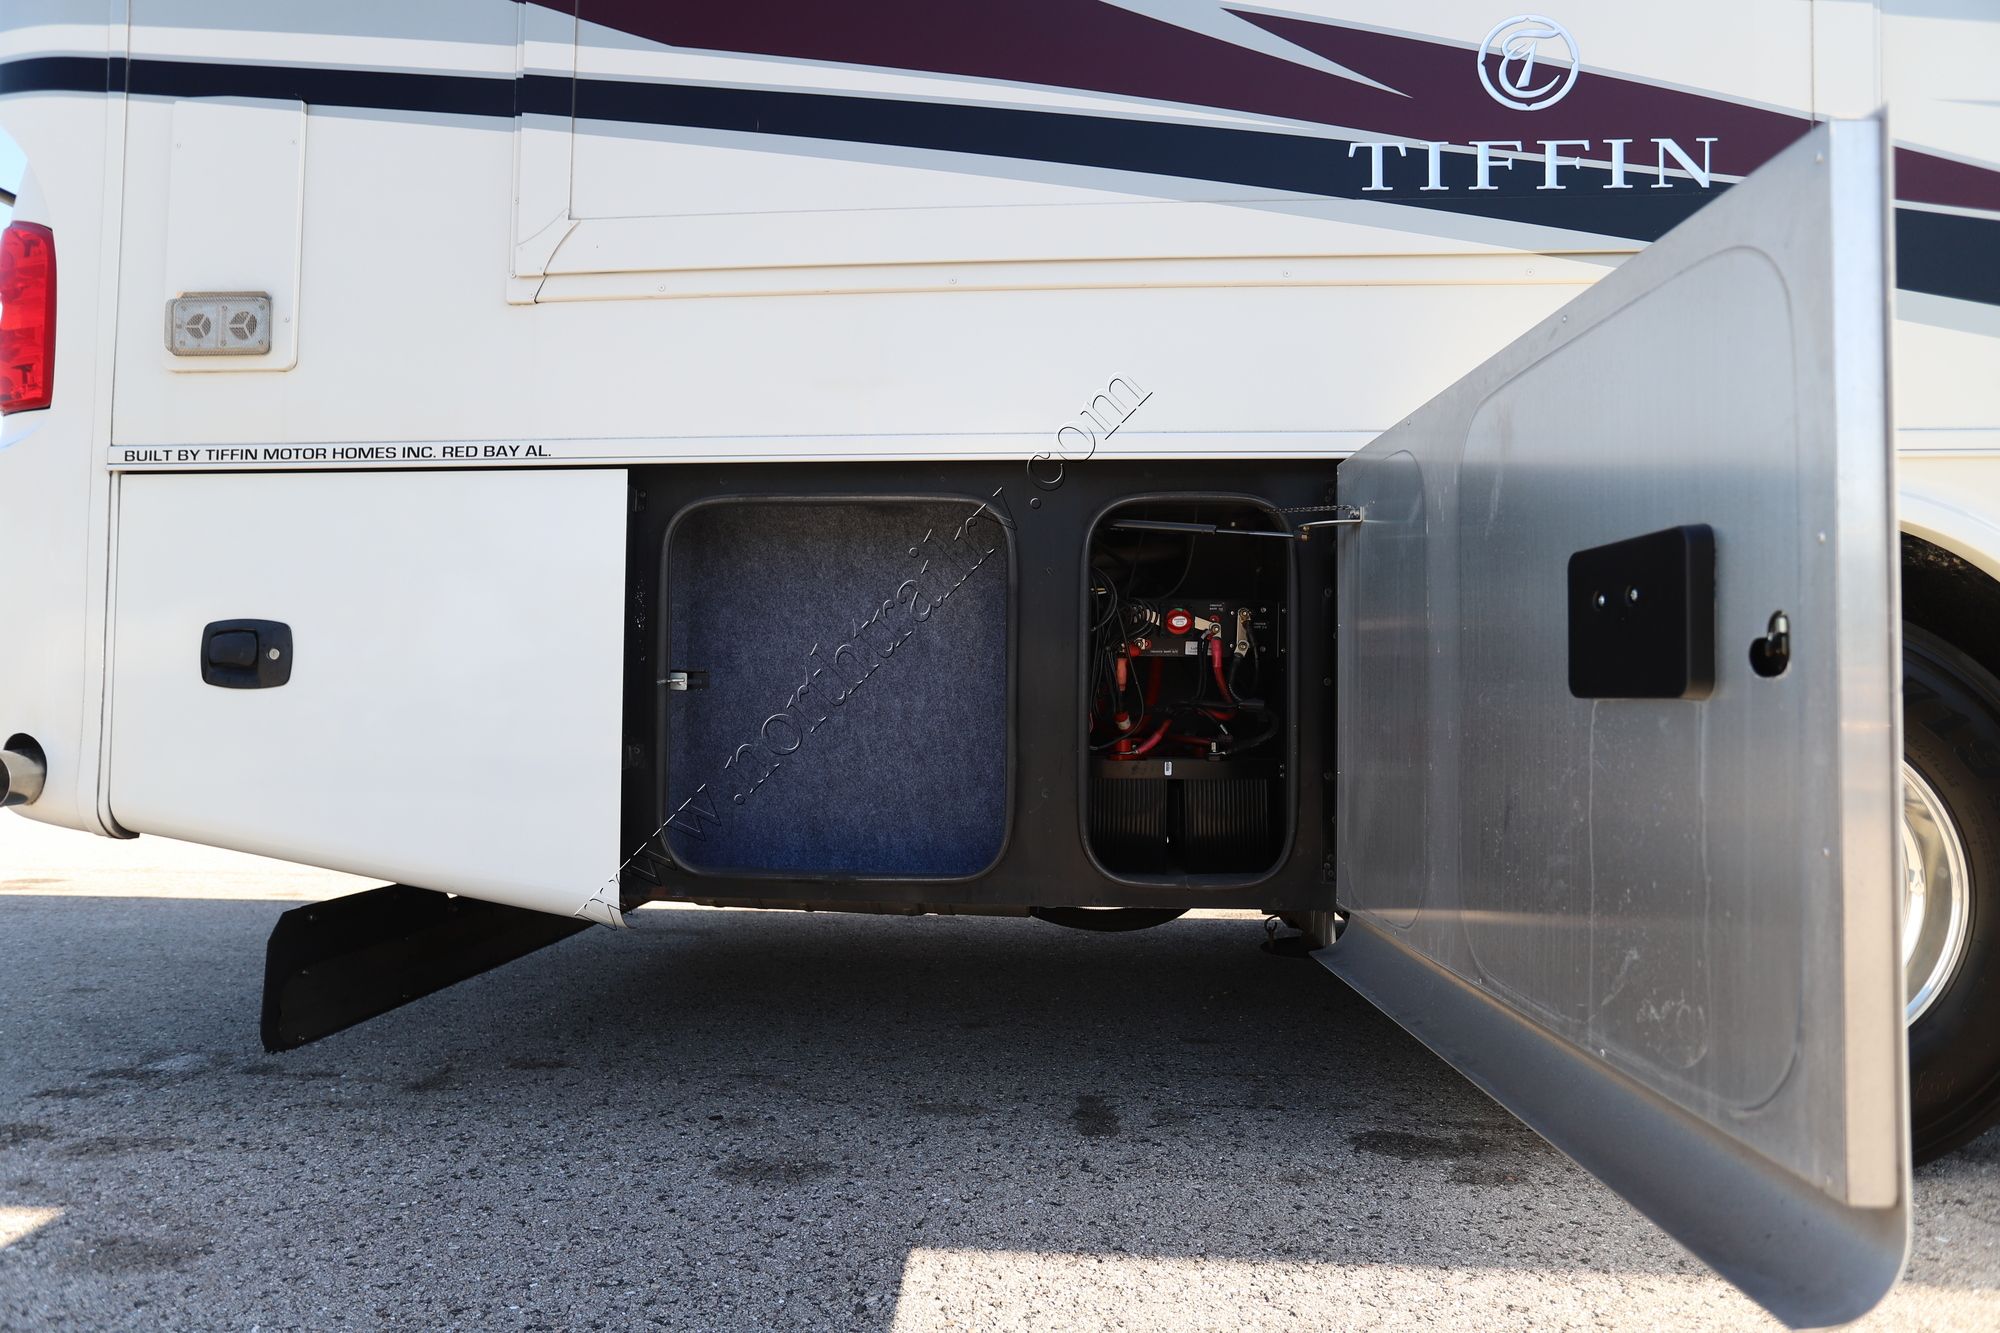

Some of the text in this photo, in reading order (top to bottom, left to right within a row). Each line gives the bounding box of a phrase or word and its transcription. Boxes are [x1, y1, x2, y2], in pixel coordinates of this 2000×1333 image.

[1347, 137, 1719, 192] TIFFIN
[124, 444, 552, 462] BUILT BY TIFFIN MOTOR HOMES INC. RED BAY AL.
